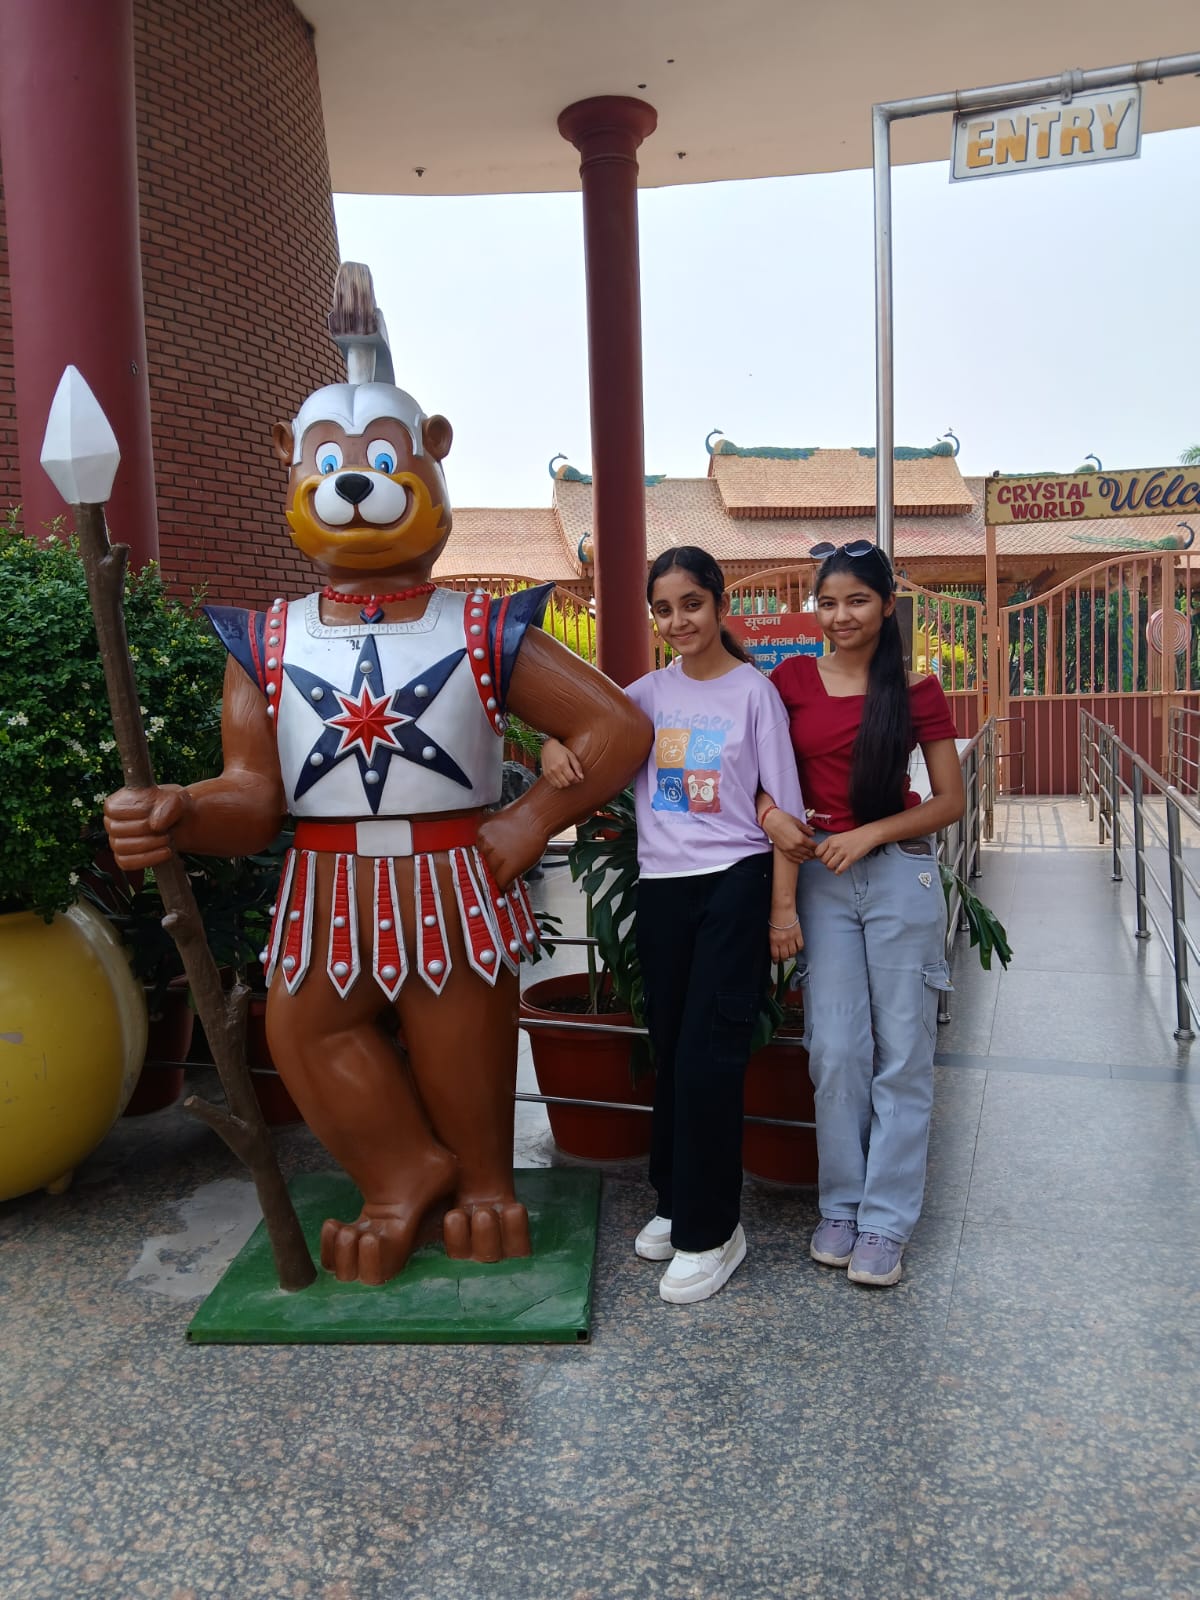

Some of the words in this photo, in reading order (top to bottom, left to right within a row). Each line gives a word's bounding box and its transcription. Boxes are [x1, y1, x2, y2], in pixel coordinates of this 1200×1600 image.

[966, 99, 1132, 169] ENTRY
[997, 481, 1092, 504] CRYSTAL
[1097, 471, 1200, 512] Welc
[1010, 500, 1085, 520] WORLD
[744, 616, 781, 631] सूचना
[761, 634, 770, 646] में
[771, 637, 793, 647] शराब
[796, 634, 816, 645] पीना
